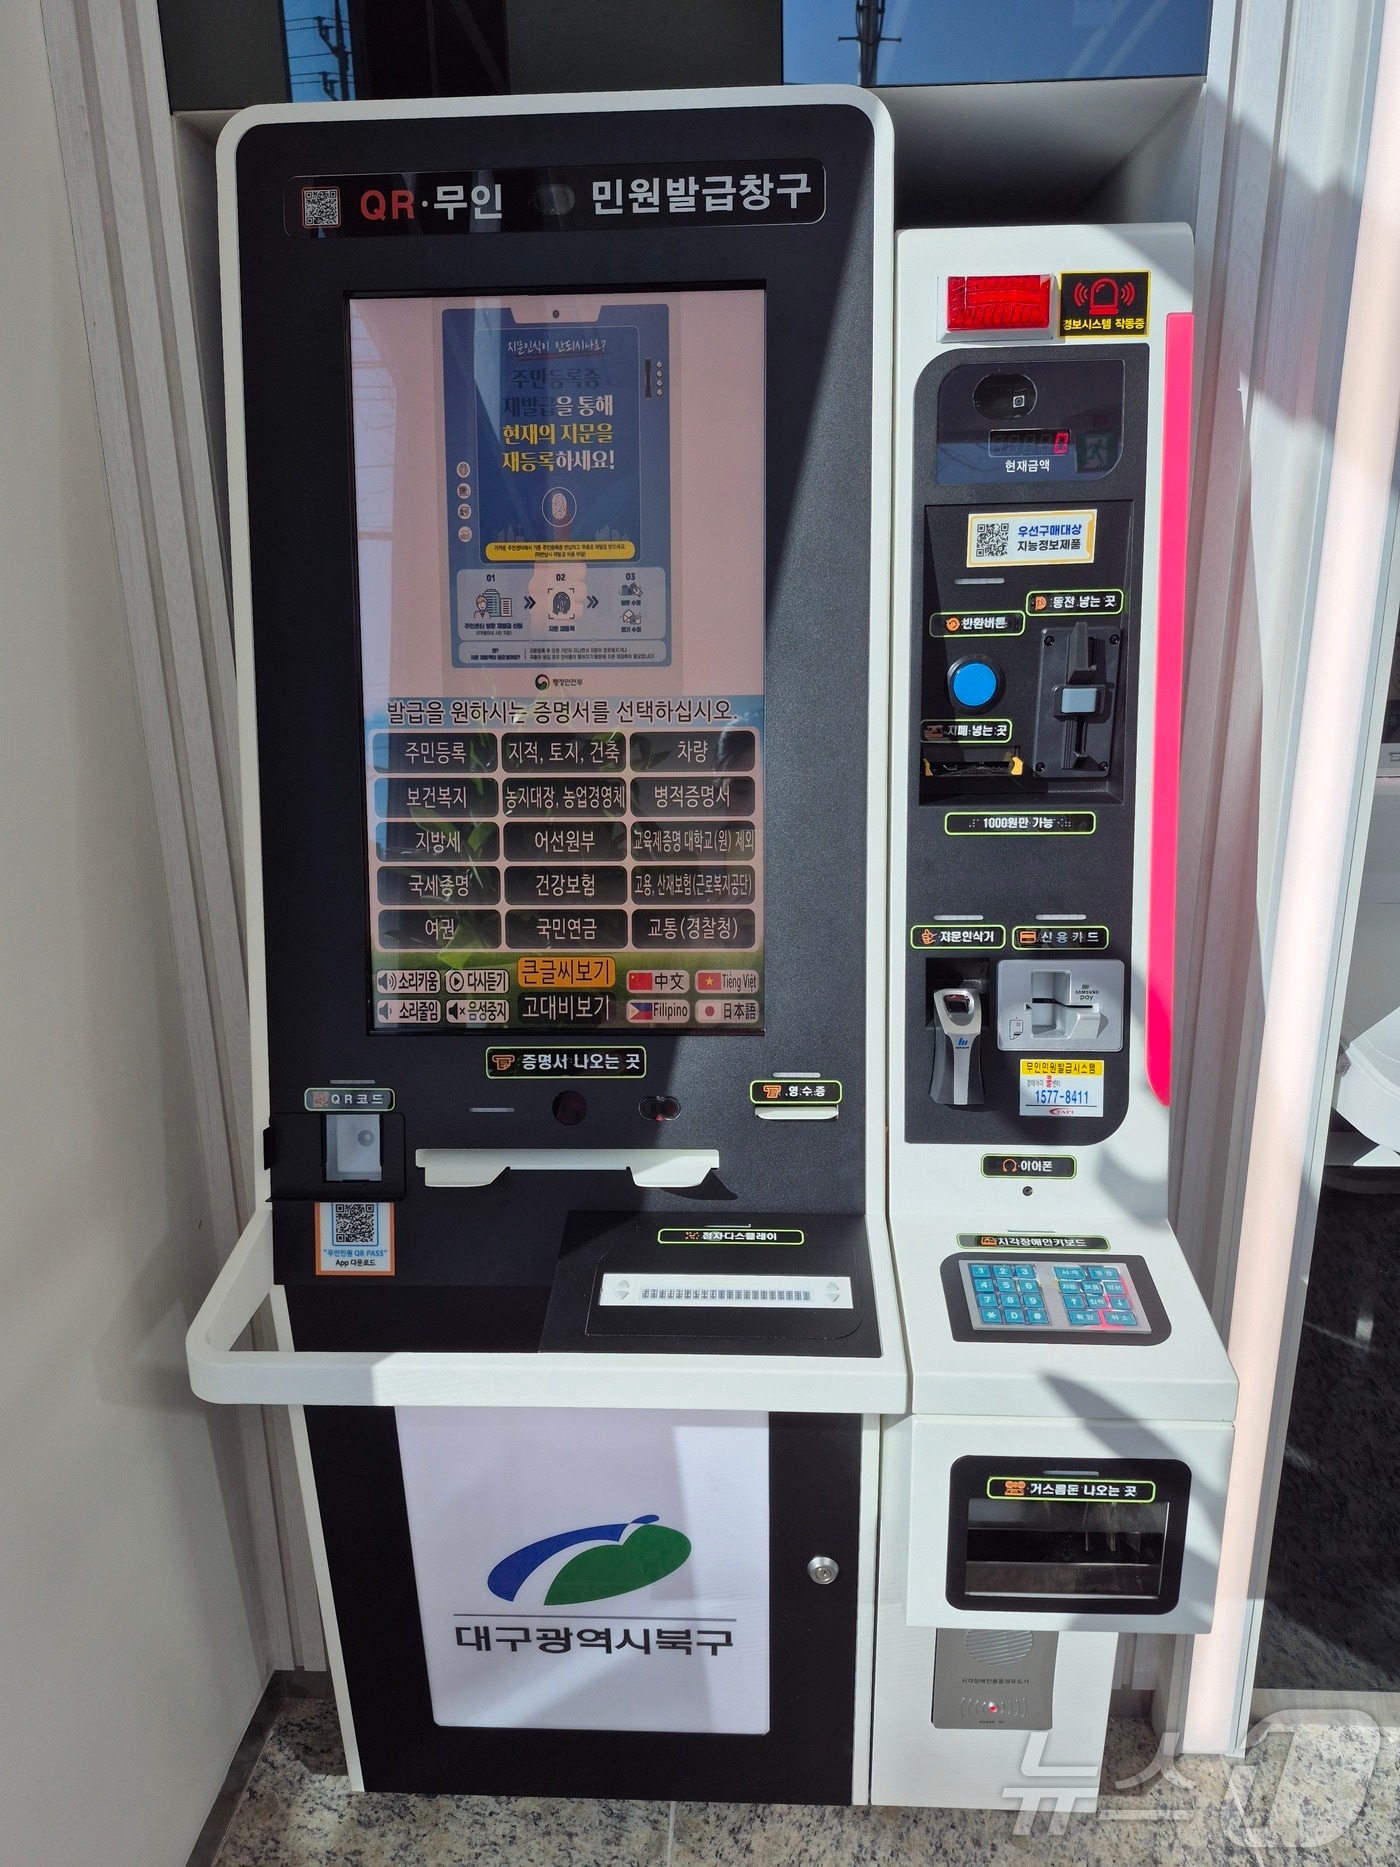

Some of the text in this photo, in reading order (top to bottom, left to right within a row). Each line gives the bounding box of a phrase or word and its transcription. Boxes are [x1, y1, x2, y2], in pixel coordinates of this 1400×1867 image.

[360, 173, 812, 221] QR·무인 민원발급창구
[1063, 319, 1145, 331] 경보시스템 작동중
[507, 339, 606, 355] 지문인식이 안되시나요?
[511, 368, 600, 389] 주민등록증
[504, 395, 613, 417] 재발급을 통해
[502, 423, 613, 445] 현재의 지문을
[1054, 433, 1069, 454] 0
[502, 450, 615, 472] 재등록하세요!
[1005, 459, 1050, 473] 현재금액
[1018, 524, 1082, 537] 우선구매대상
[1017, 539, 1081, 552] 지능정보제품
[486, 574, 496, 582] 01
[625, 572, 636, 581] 03
[1052, 595, 1116, 608] 동전 넣는 곳
[962, 617, 1007, 630] 반환버튼
[388, 700, 738, 724] 발급을 원하시는 증명서를 선택하십시오.
[947, 724, 1007, 737] 지폐 넣는 곳
[405, 742, 467, 764] 주민등록
[508, 741, 621, 765] 지적, 토지, 건축
[677, 740, 708, 763] 차량
[406, 787, 467, 809] 보건복지
[505, 785, 626, 810] 농지대장, 농업경영체
[654, 785, 730, 808] 병적증명서
[983, 817, 1054, 829] 1000원만 가능
[415, 832, 461, 854] 지방세
[534, 831, 595, 853] 어선원부
[633, 829, 755, 853] 교육제증명 대학교(원) 제외
[408, 875, 469, 896] 국세증명
[535, 874, 596, 896] 건강보험
[634, 873, 752, 896] 고용, 산재보험(근로복지공단)
[424, 918, 456, 940] 여권
[536, 917, 597, 939] 국민연금
[647, 917, 738, 940] 교통(경찰청)
[1041, 931, 1099, 943] 신용카드
[522, 959, 610, 985] 큰글씨보기
[654, 972, 685, 990] 中文
[398, 971, 439, 992] 소리키움
[467, 971, 506, 992] 다시듣기
[722, 971, 757, 992] Tiếng Việt
[398, 1001, 438, 1021] 소리줄임
[467, 1001, 506, 1021] 음성중지
[522, 997, 610, 1021] 고대비보기
[653, 1002, 688, 1020] Filipino
[723, 1002, 756, 1020] 日本語
[522, 1053, 641, 1070] 증명서 나오는 곳
[1026, 1062, 1096, 1075] 무인민원발급시스템
[331, 1094, 383, 1104] QR코드
[788, 1085, 826, 1097] 영수증
[1035, 1090, 1088, 1104] 1577-8411
[1020, 1160, 1053, 1172] 이어폰
[702, 1231, 777, 1241] 점자디스플레이
[998, 1237, 1087, 1248] 시각장애인키보드
[354, 1249, 365, 1257] QR
[335, 1259, 376, 1267] App 다운로드
[999, 1267, 1007, 1275] 2
[1003, 1281, 1010, 1289] 5
[1025, 1282, 1032, 1290] 6
[1007, 1296, 1014, 1304] 8
[1010, 1311, 1018, 1319] 0
[1030, 1482, 1137, 1497] 거스름돈 나오는 곳
[455, 1625, 734, 1656] 대구광역시북구
